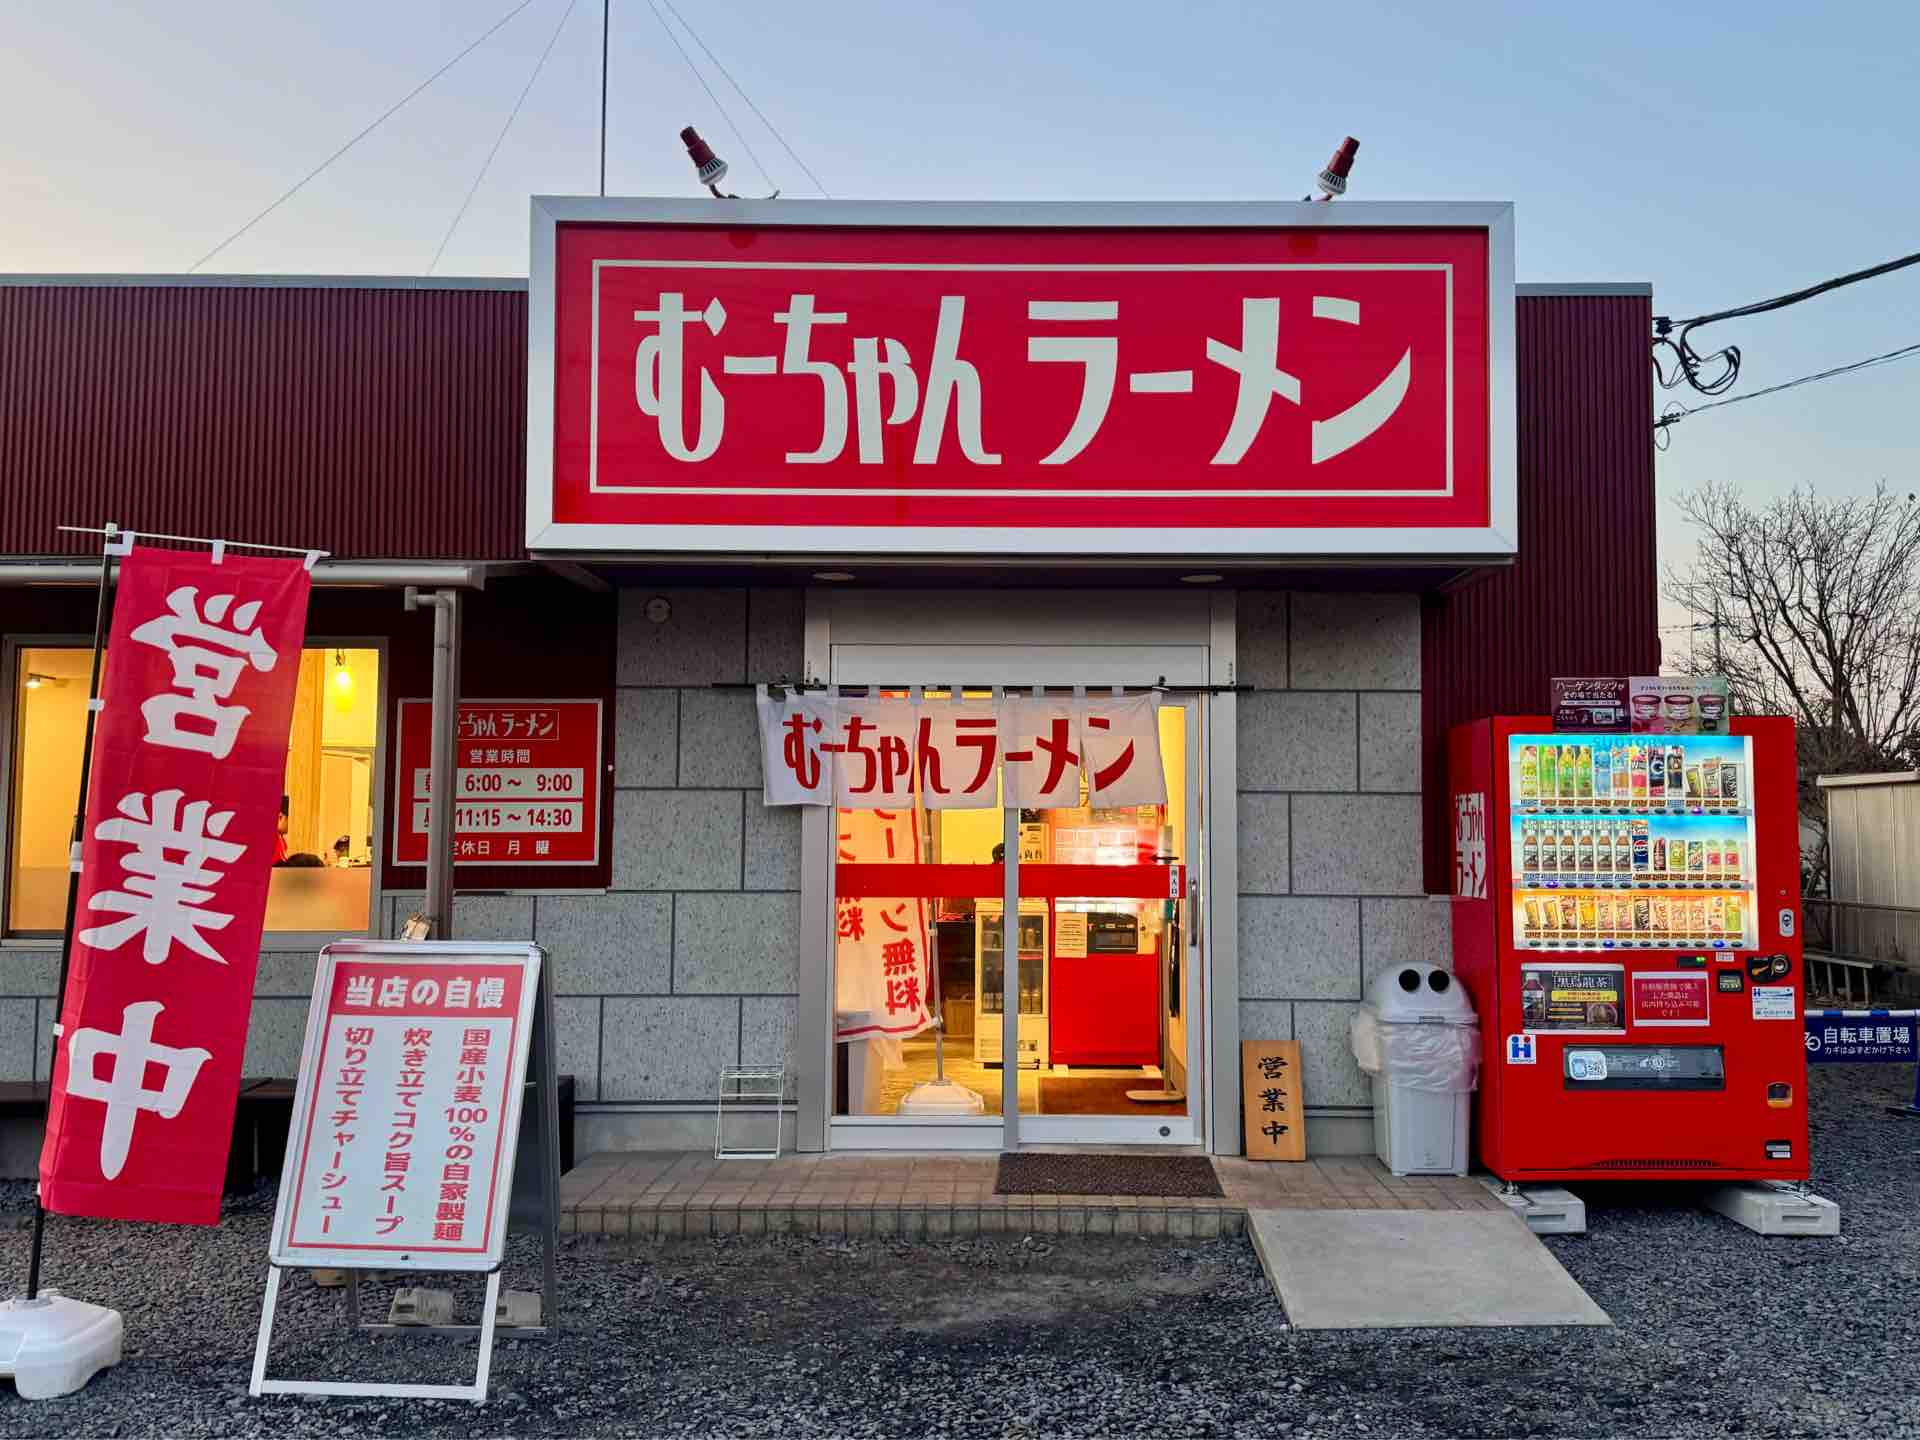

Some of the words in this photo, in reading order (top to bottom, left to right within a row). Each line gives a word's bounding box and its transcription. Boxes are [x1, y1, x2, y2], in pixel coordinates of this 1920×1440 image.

[465, 774, 501, 791] 6:00
[536, 774, 573, 791] 9:00
[470, 749, 531, 764] 営業時間
[782, 713, 1135, 795] むーちゃんラーメン
[456, 808, 500, 826] 11:15
[527, 808, 573, 826] 14:30
[66, 586, 278, 1181] 営業中
[344, 976, 506, 1008] 当店の自慢
[1824, 1026, 1910, 1044] 自転車置場
[1256, 1055, 1289, 1145] 営業中
[320, 1026, 374, 1234] 切り立てチャーシュー
[375, 1027, 433, 1235] 炊き立てコク旨スープ
